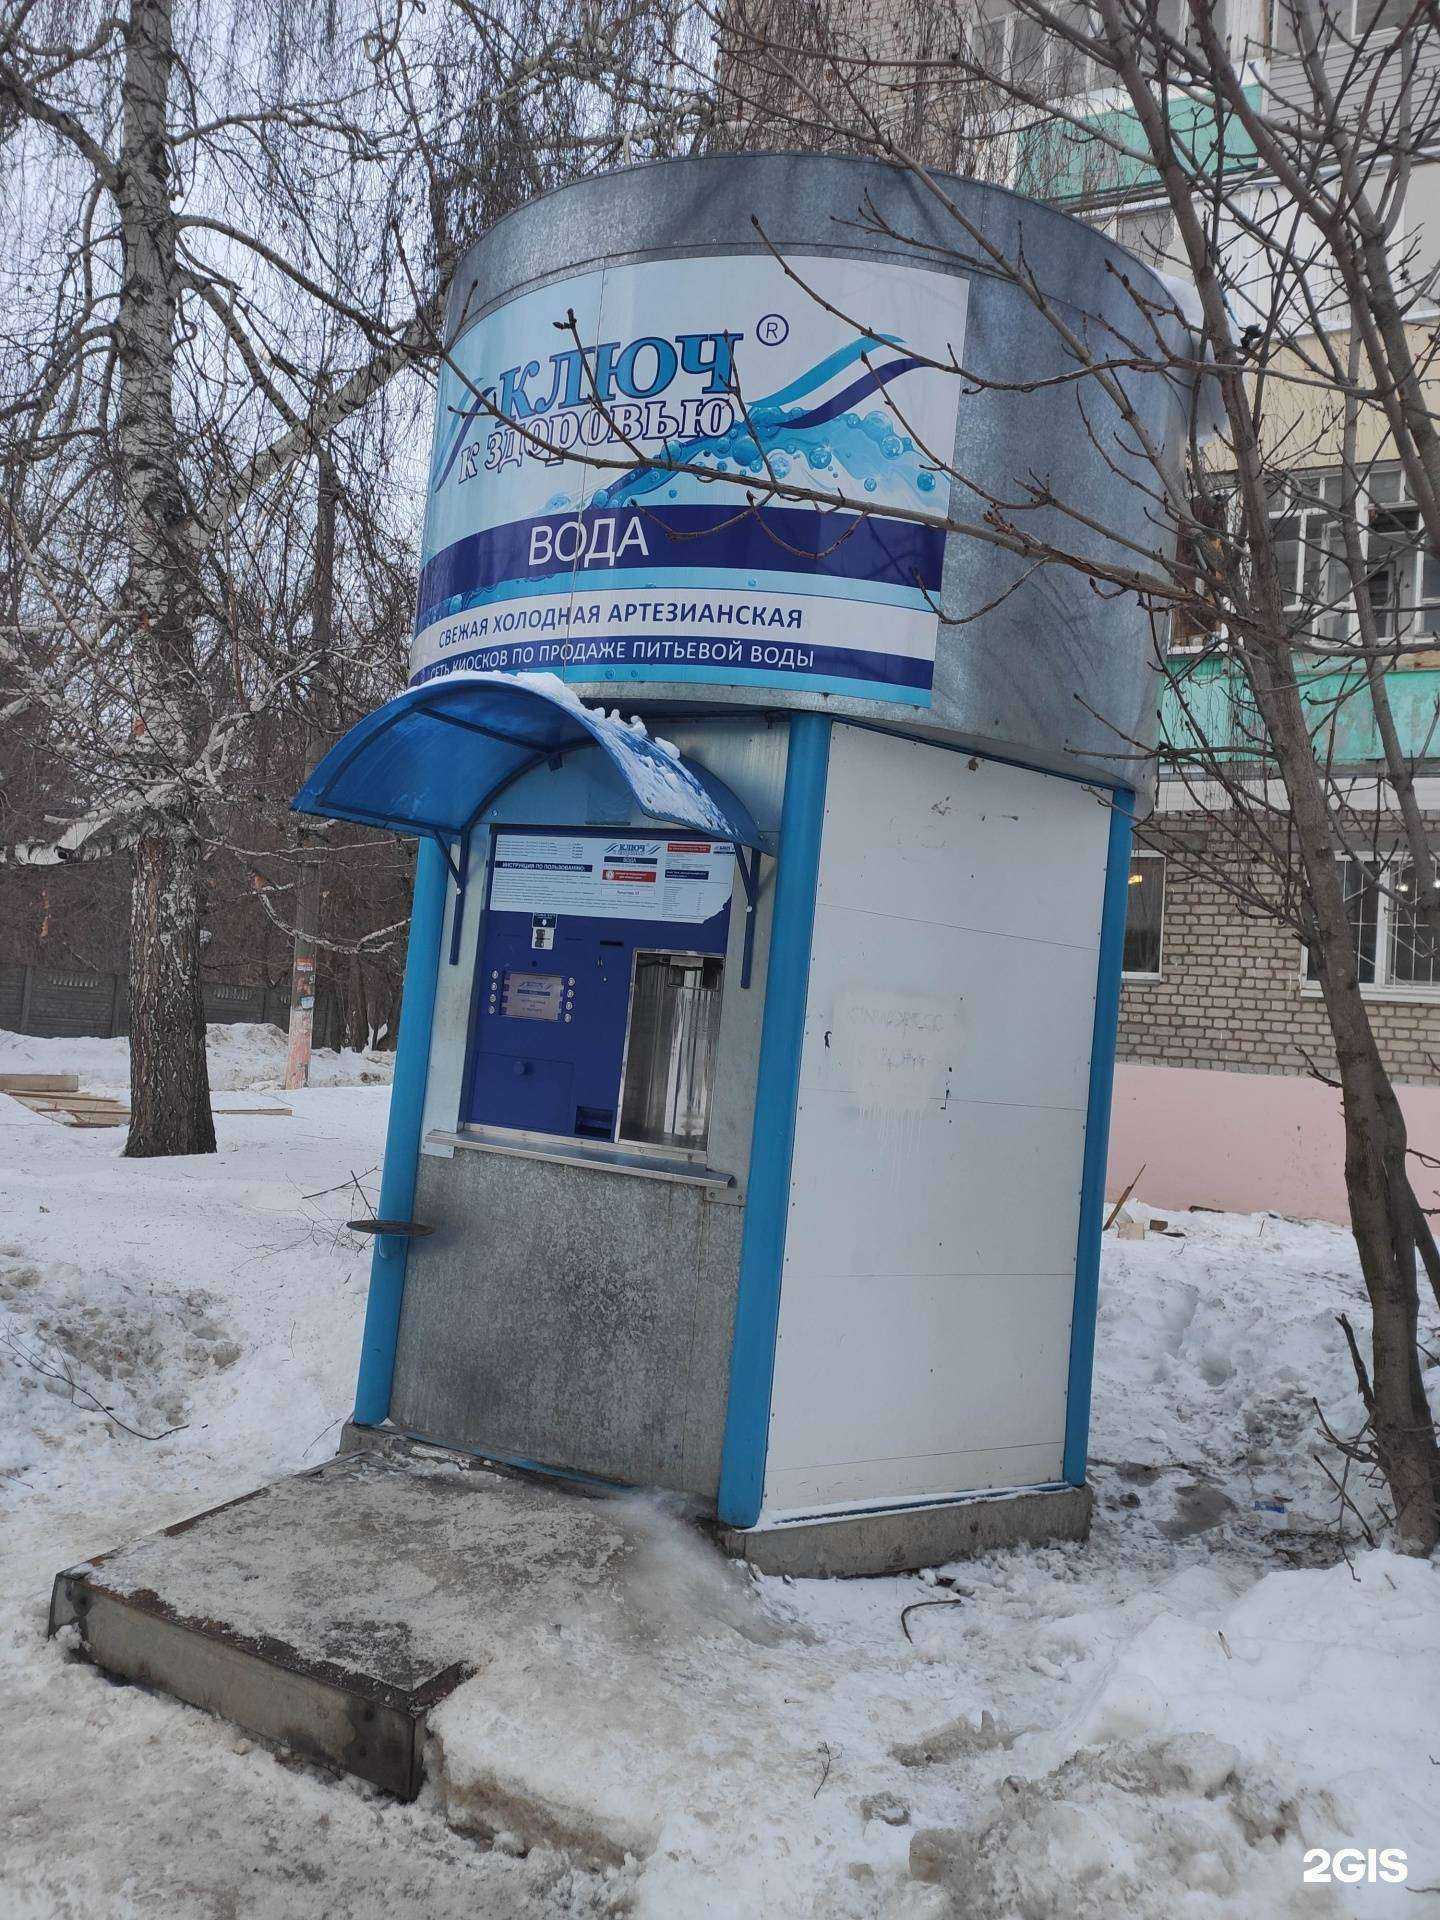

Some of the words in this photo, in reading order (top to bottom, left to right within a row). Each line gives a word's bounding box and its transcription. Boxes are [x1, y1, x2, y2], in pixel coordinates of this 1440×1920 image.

[495, 332, 744, 428] КЛЮЧ
[458, 442, 480, 484] К
[484, 397, 735, 473] ЗДОРОВЬЮ
[528, 516, 649, 569] ВОДА
[438, 619, 488, 649] СВЕЖАЯ
[492, 605, 600, 634] ХОЛОДНАЯ
[606, 602, 802, 629] АРТЕЗИАНСКАЯ
[452, 649, 508, 672] КИОСКОВ
[512, 647, 534, 664] ПО
[539, 641, 626, 663] ПРОДАЖЕ
[632, 639, 743, 661] ПИТЬЕВОЙ
[750, 648, 814, 668] ВОДЫ
